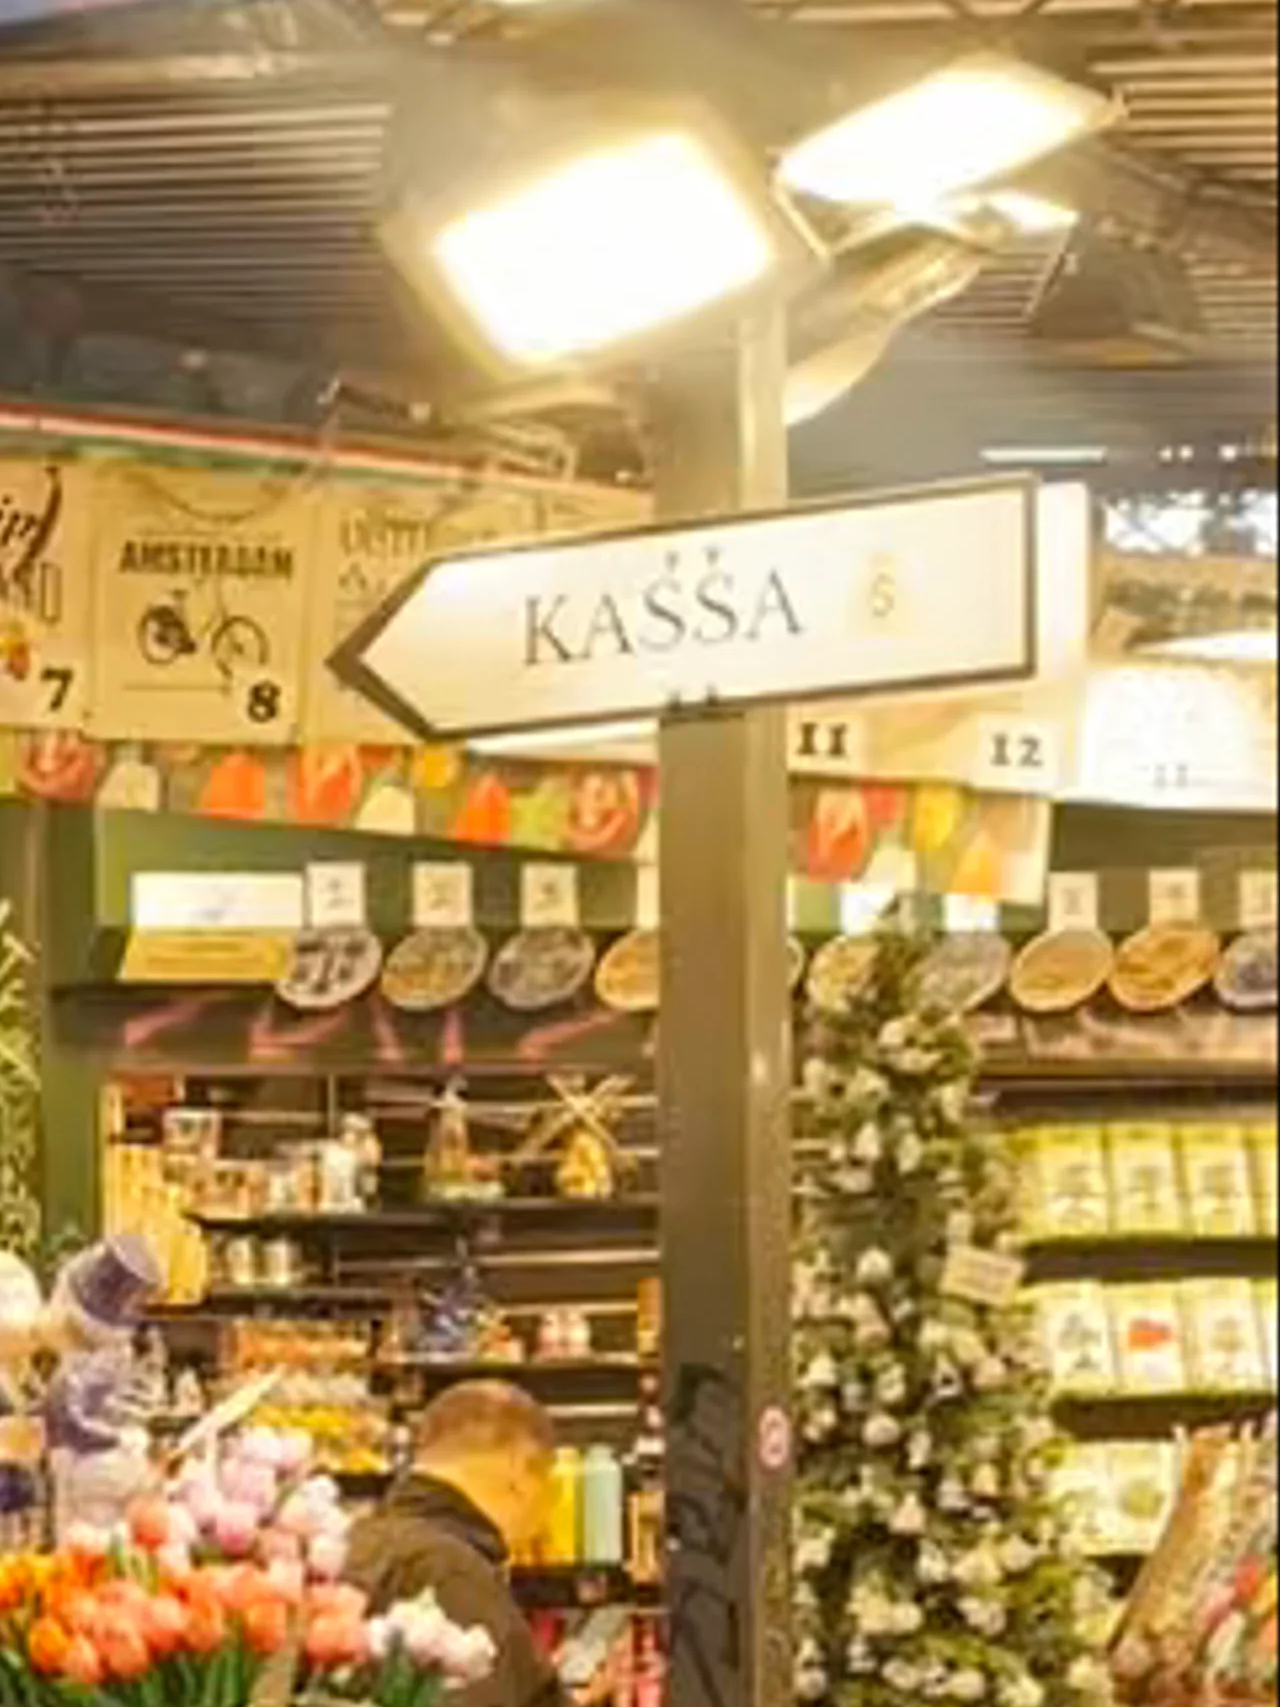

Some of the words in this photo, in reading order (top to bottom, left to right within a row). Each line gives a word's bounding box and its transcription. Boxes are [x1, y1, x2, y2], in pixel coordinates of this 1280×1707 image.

[518, 568, 804, 667] KASSA
[40, 668, 74, 713] 7
[246, 679, 282, 724] 8
[795, 722, 850, 759] 11
[989, 732, 1045, 768] 12
